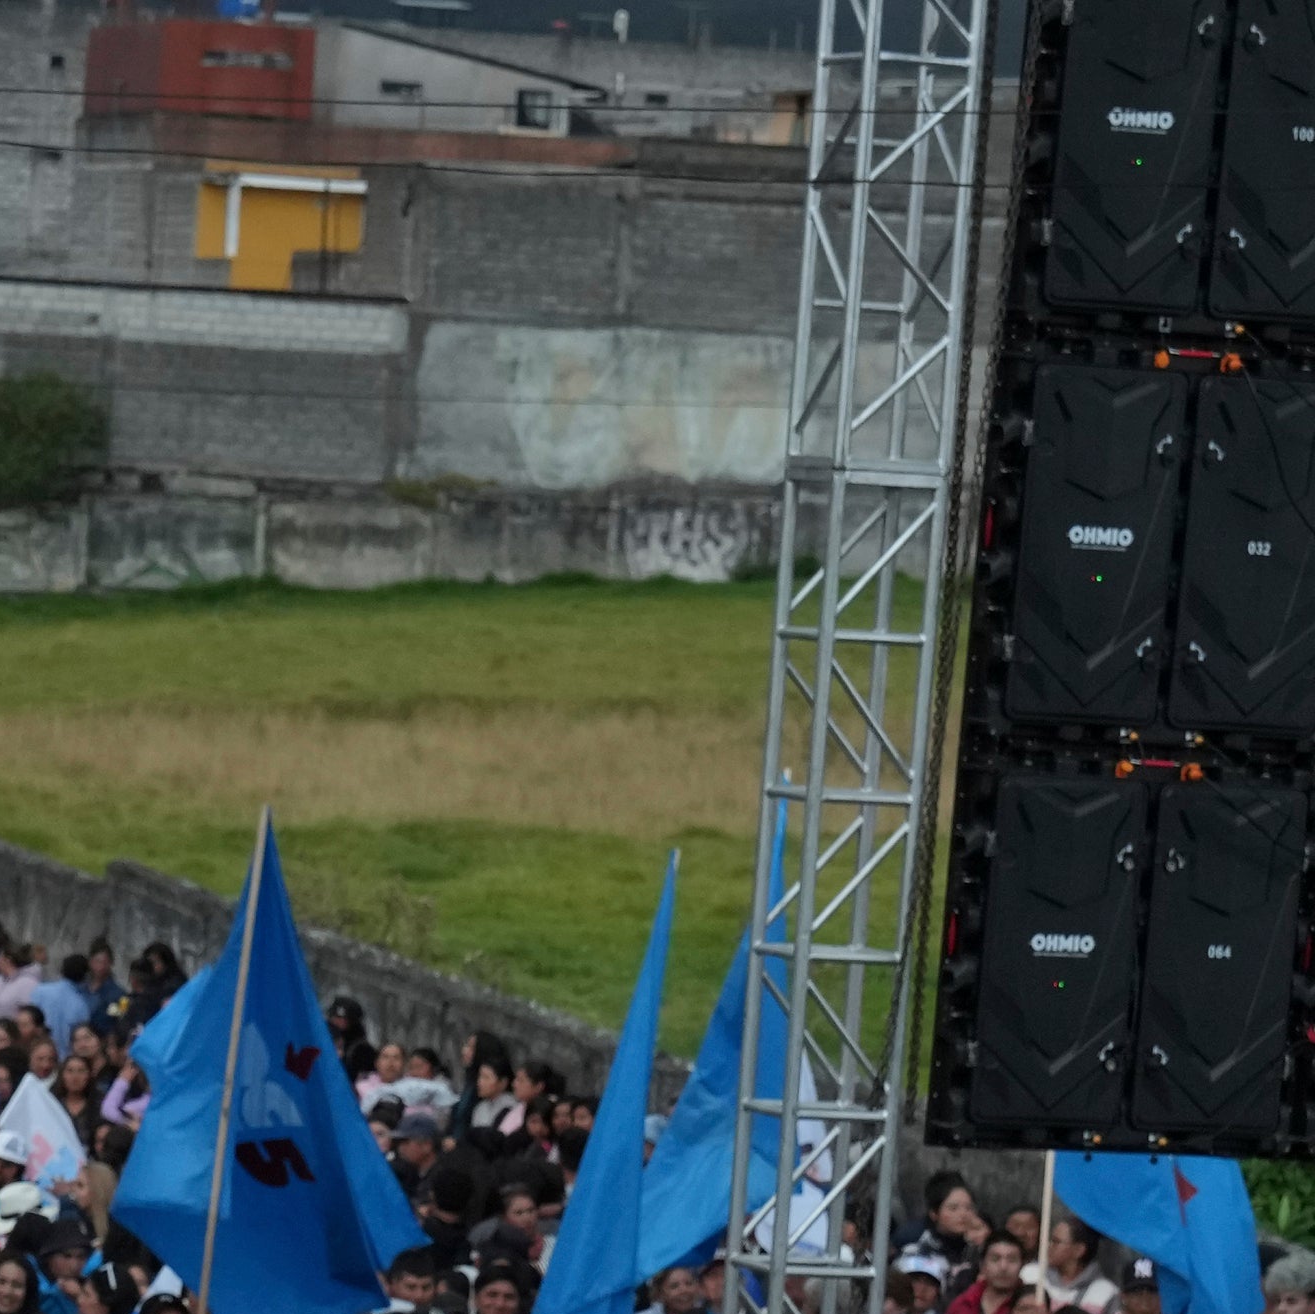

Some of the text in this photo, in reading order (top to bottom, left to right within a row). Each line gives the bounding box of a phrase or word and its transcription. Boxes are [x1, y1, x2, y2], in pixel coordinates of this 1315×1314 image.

[1107, 107, 1175, 130] OHMIO
[1067, 525, 1134, 547] OHMIO
[1247, 541, 1271, 557] 032
[1030, 933, 1096, 954] OHMIO
